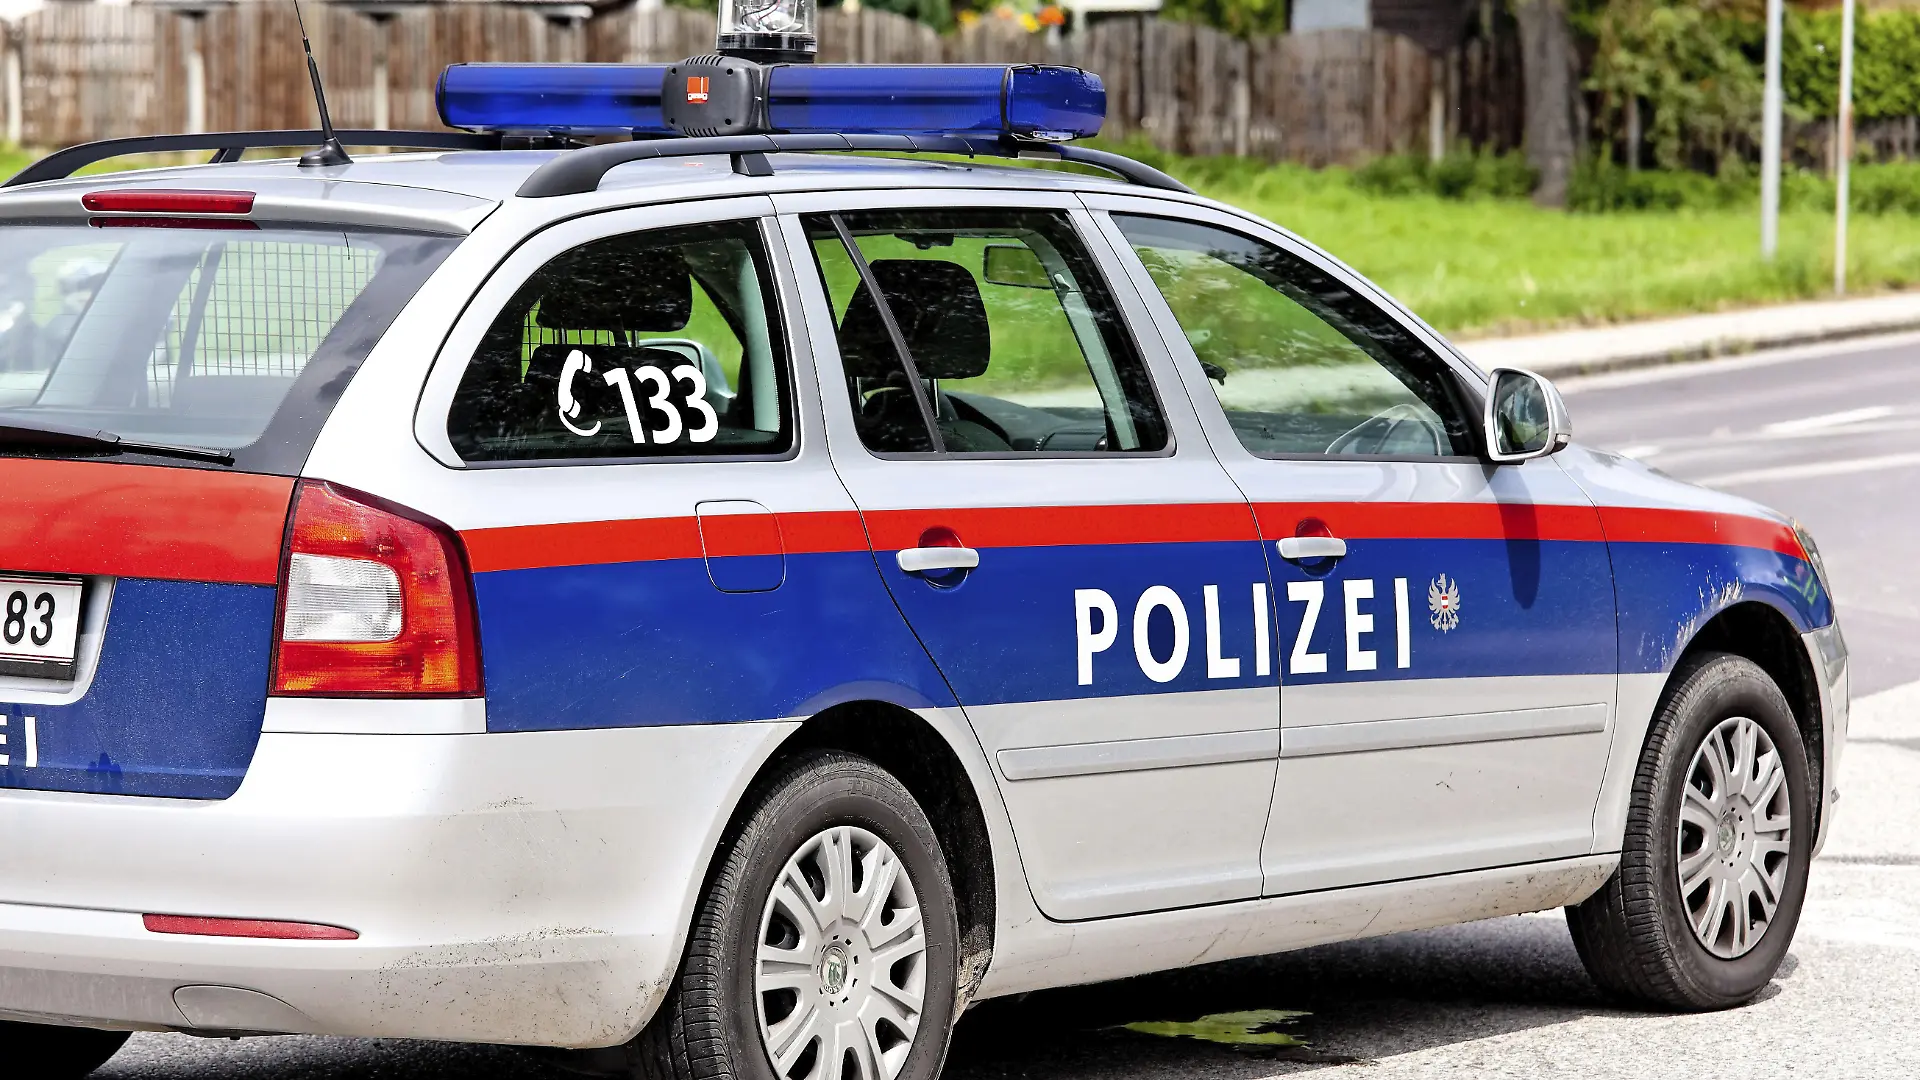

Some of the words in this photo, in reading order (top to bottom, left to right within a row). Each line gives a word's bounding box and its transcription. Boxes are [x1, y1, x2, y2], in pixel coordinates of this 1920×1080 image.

[602, 365, 719, 444] 133
[4, 590, 56, 646] 83
[1074, 577, 1411, 686] POLIZEI
